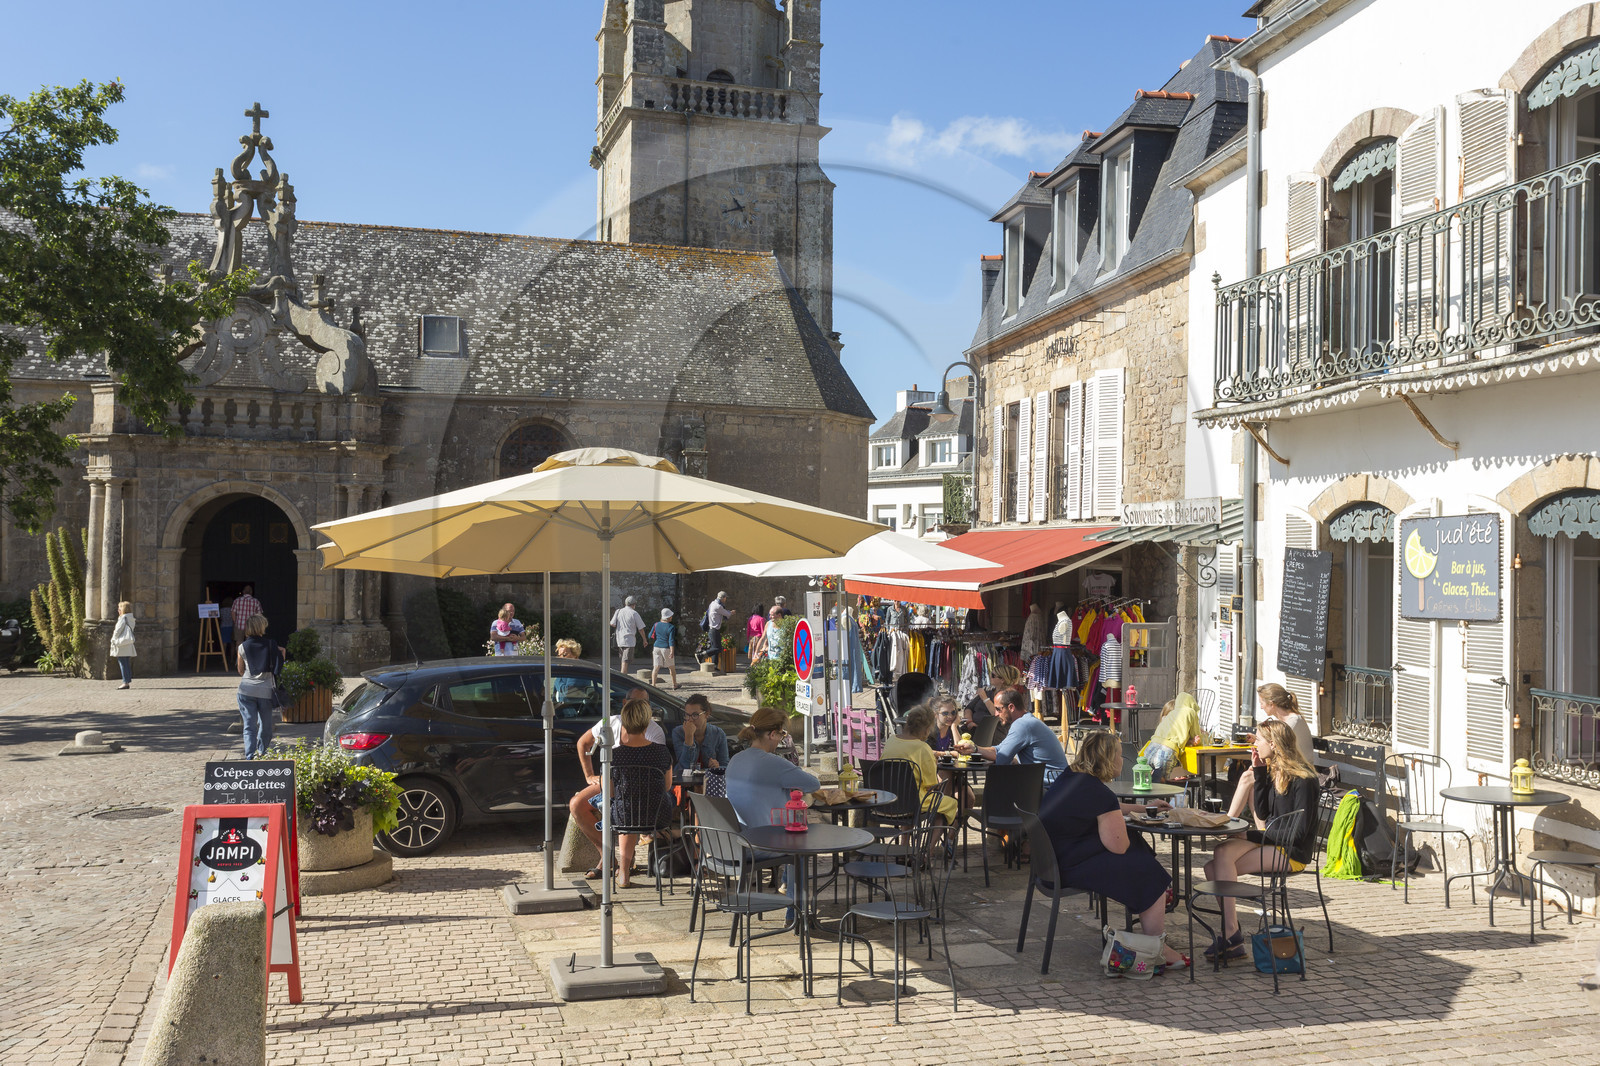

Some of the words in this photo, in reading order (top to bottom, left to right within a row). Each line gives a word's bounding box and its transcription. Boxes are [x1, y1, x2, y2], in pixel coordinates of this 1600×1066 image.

[1123, 505, 1163, 524] Souvenirs
[1430, 519, 1493, 555] jud'été
[1451, 561, 1465, 574] Bar
[1466, 560, 1471, 574] à
[1471, 560, 1486, 577] jus,
[1442, 582, 1469, 597] Glaces,
[214, 767, 254, 779] Crêpes
[239, 779, 286, 790] Galettes
[206, 846, 254, 860] JAMPI
